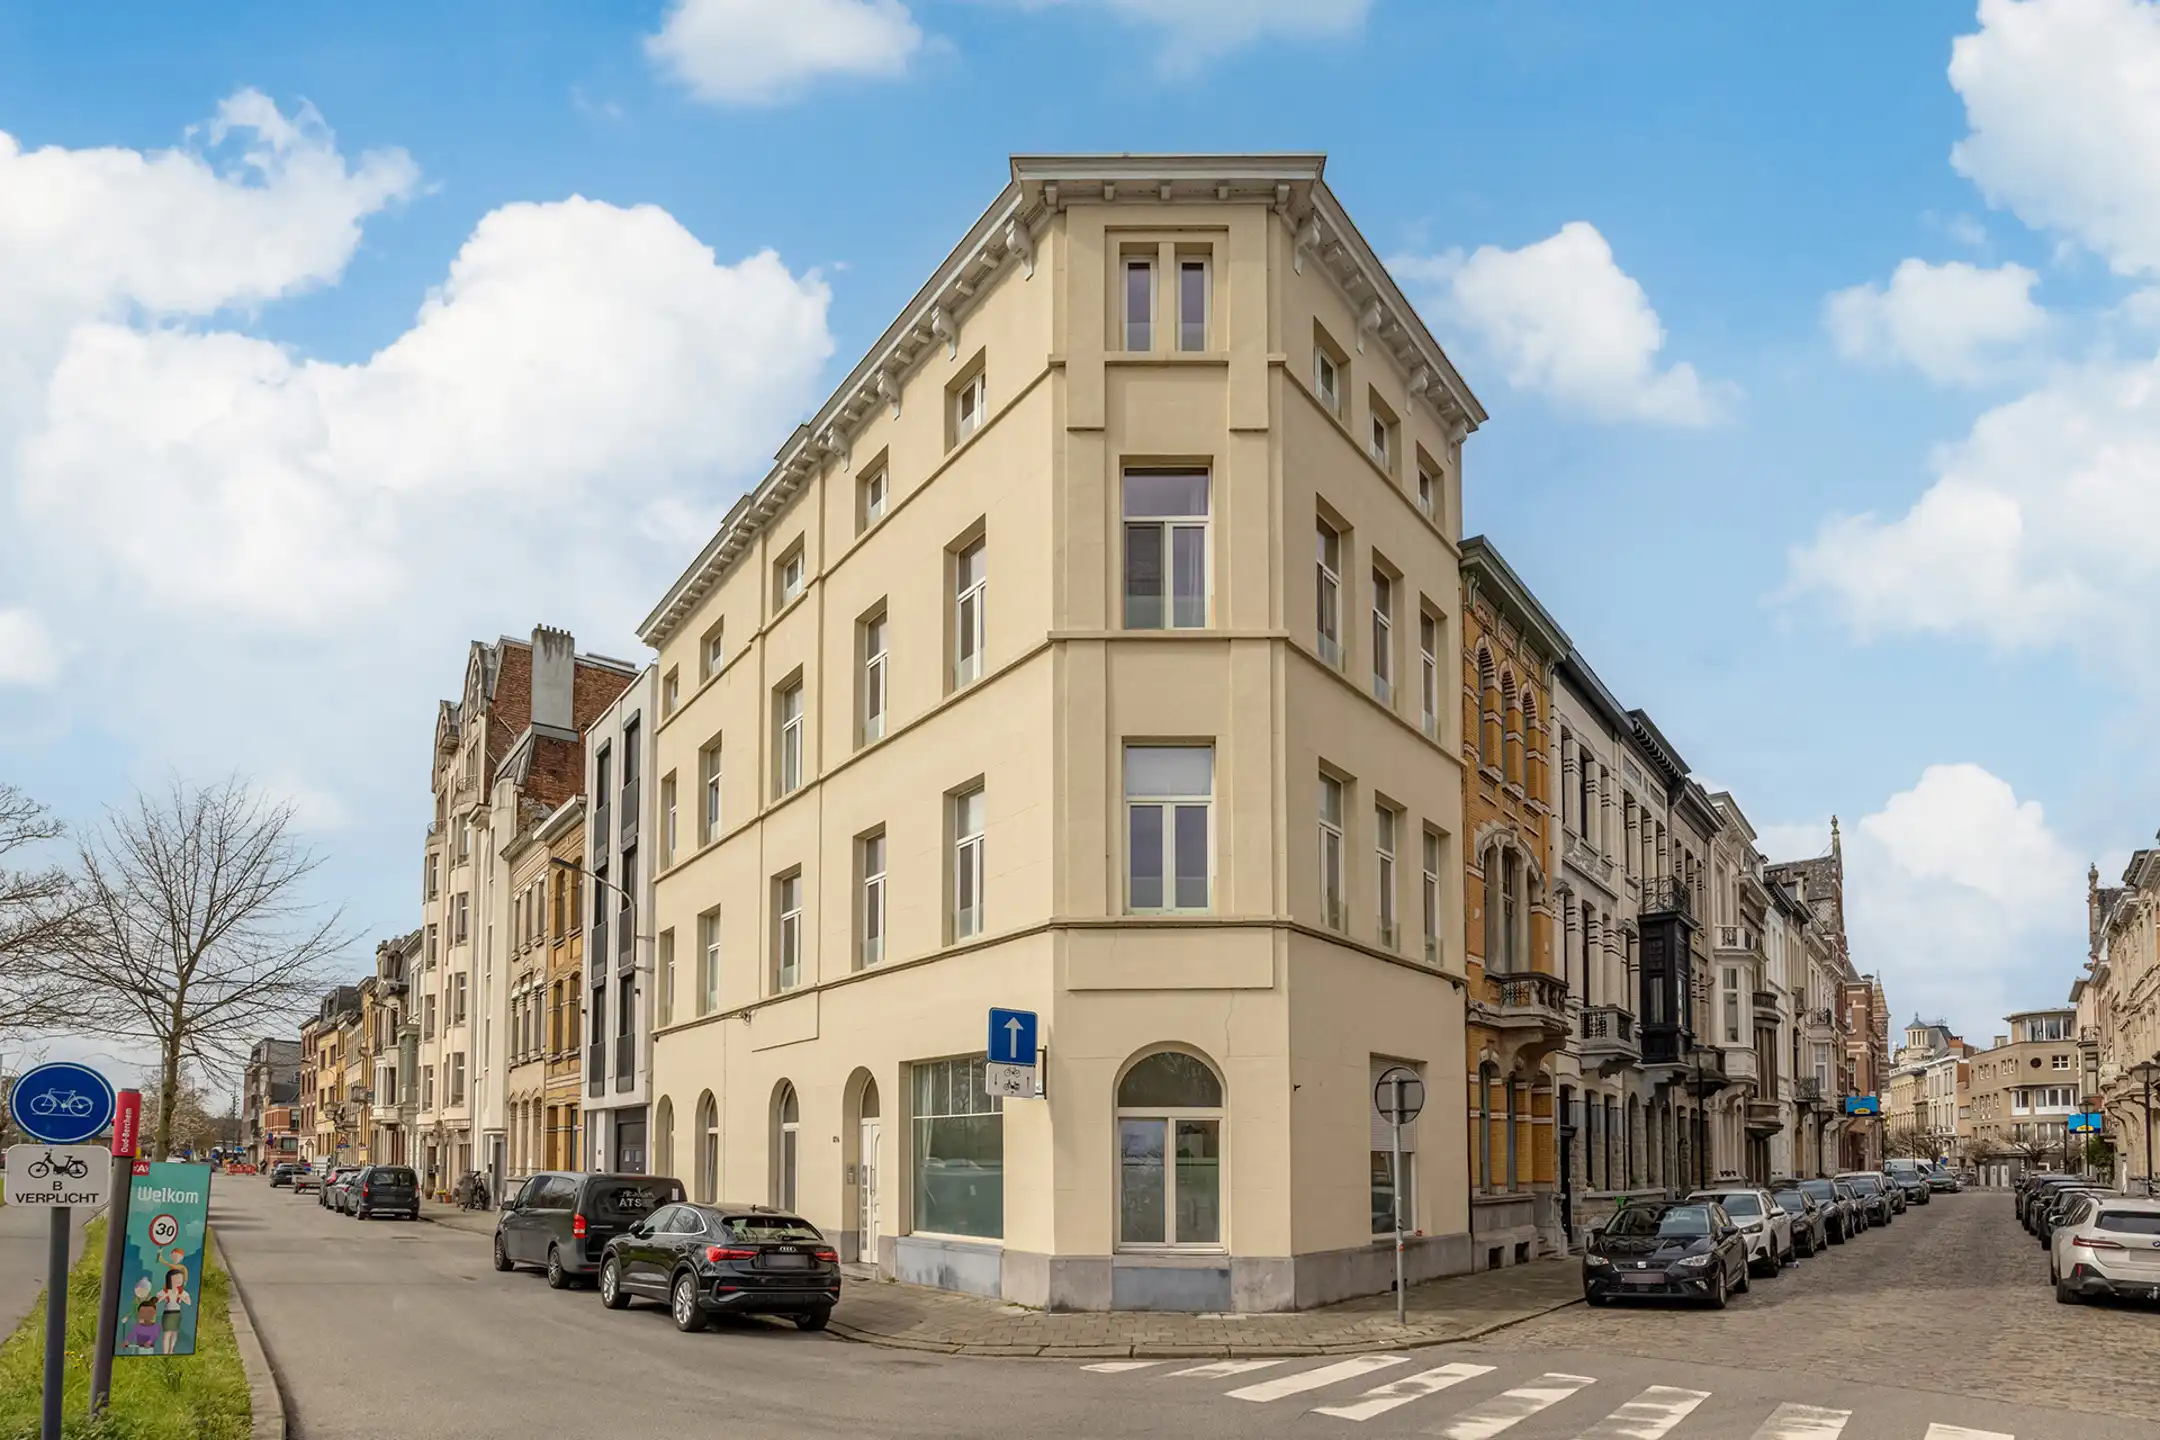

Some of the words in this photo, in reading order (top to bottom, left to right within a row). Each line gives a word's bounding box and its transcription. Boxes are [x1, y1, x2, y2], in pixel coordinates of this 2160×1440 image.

[121, 1107, 132, 1153] Oud-Berchem
[52, 1180, 63, 1191] B
[15, 1192, 99, 1204] VERPLICHT
[137, 1186, 199, 1204] Welkom
[619, 1198, 642, 1207] ATS
[155, 1222, 175, 1237] 30
